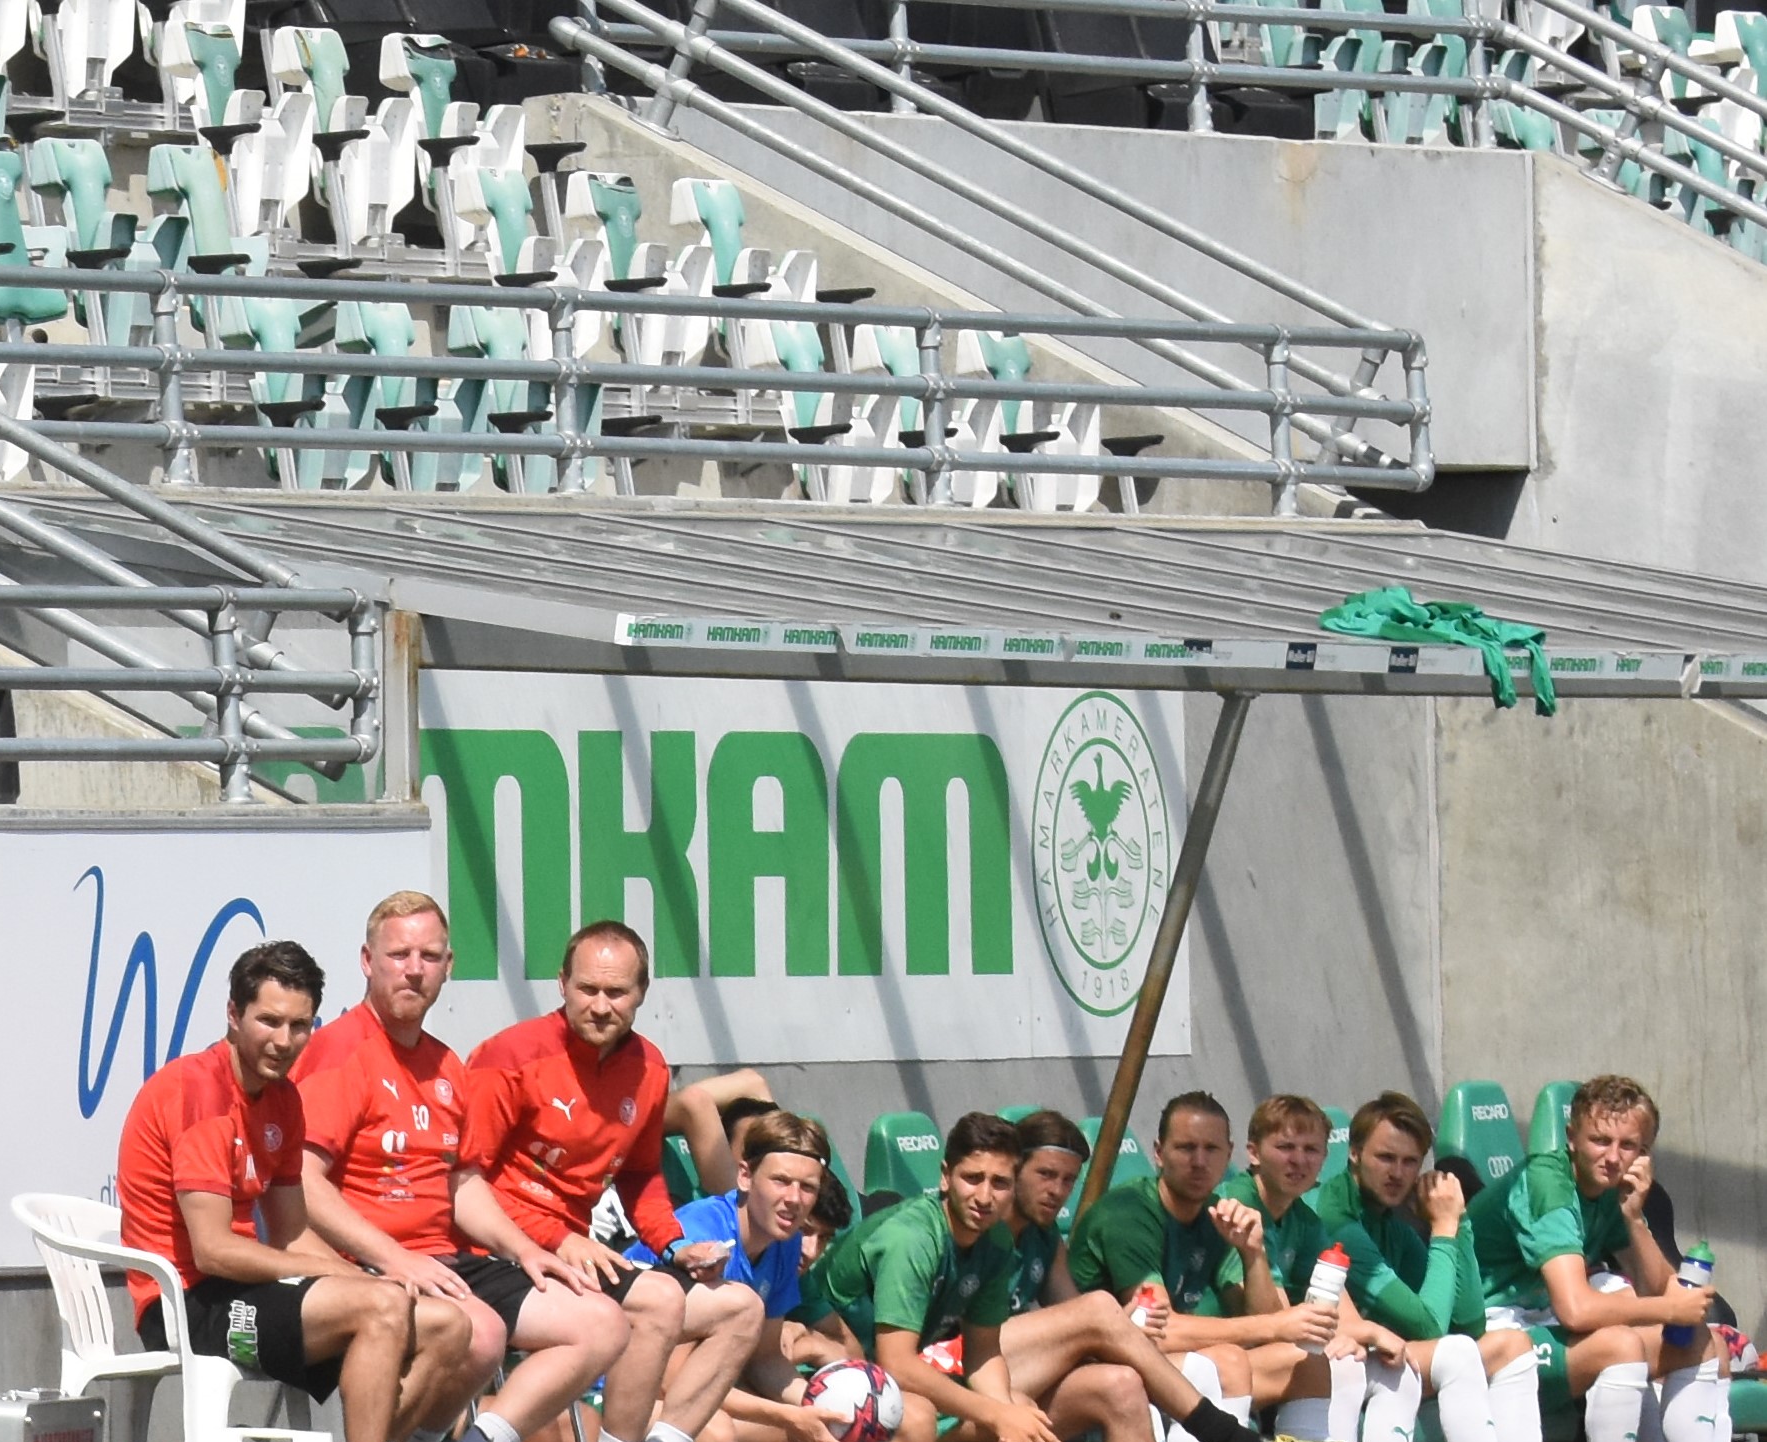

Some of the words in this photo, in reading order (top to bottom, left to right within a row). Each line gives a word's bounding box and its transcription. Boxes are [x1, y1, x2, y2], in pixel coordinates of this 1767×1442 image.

[707, 625, 761, 643] HAMKAM
[783, 628, 838, 646] HAMKAM
[855, 632, 909, 649] HAMKAM
[929, 634, 982, 652] HAMKAM
[1002, 637, 1055, 654] HAMKAM
[1549, 657, 1597, 672] HAMKAM
[1082, 969, 1131, 999] 1918
[1471, 1103, 1509, 1122] RECARO
[896, 1134, 940, 1152] RECARO
[100, 1174, 117, 1209] di
